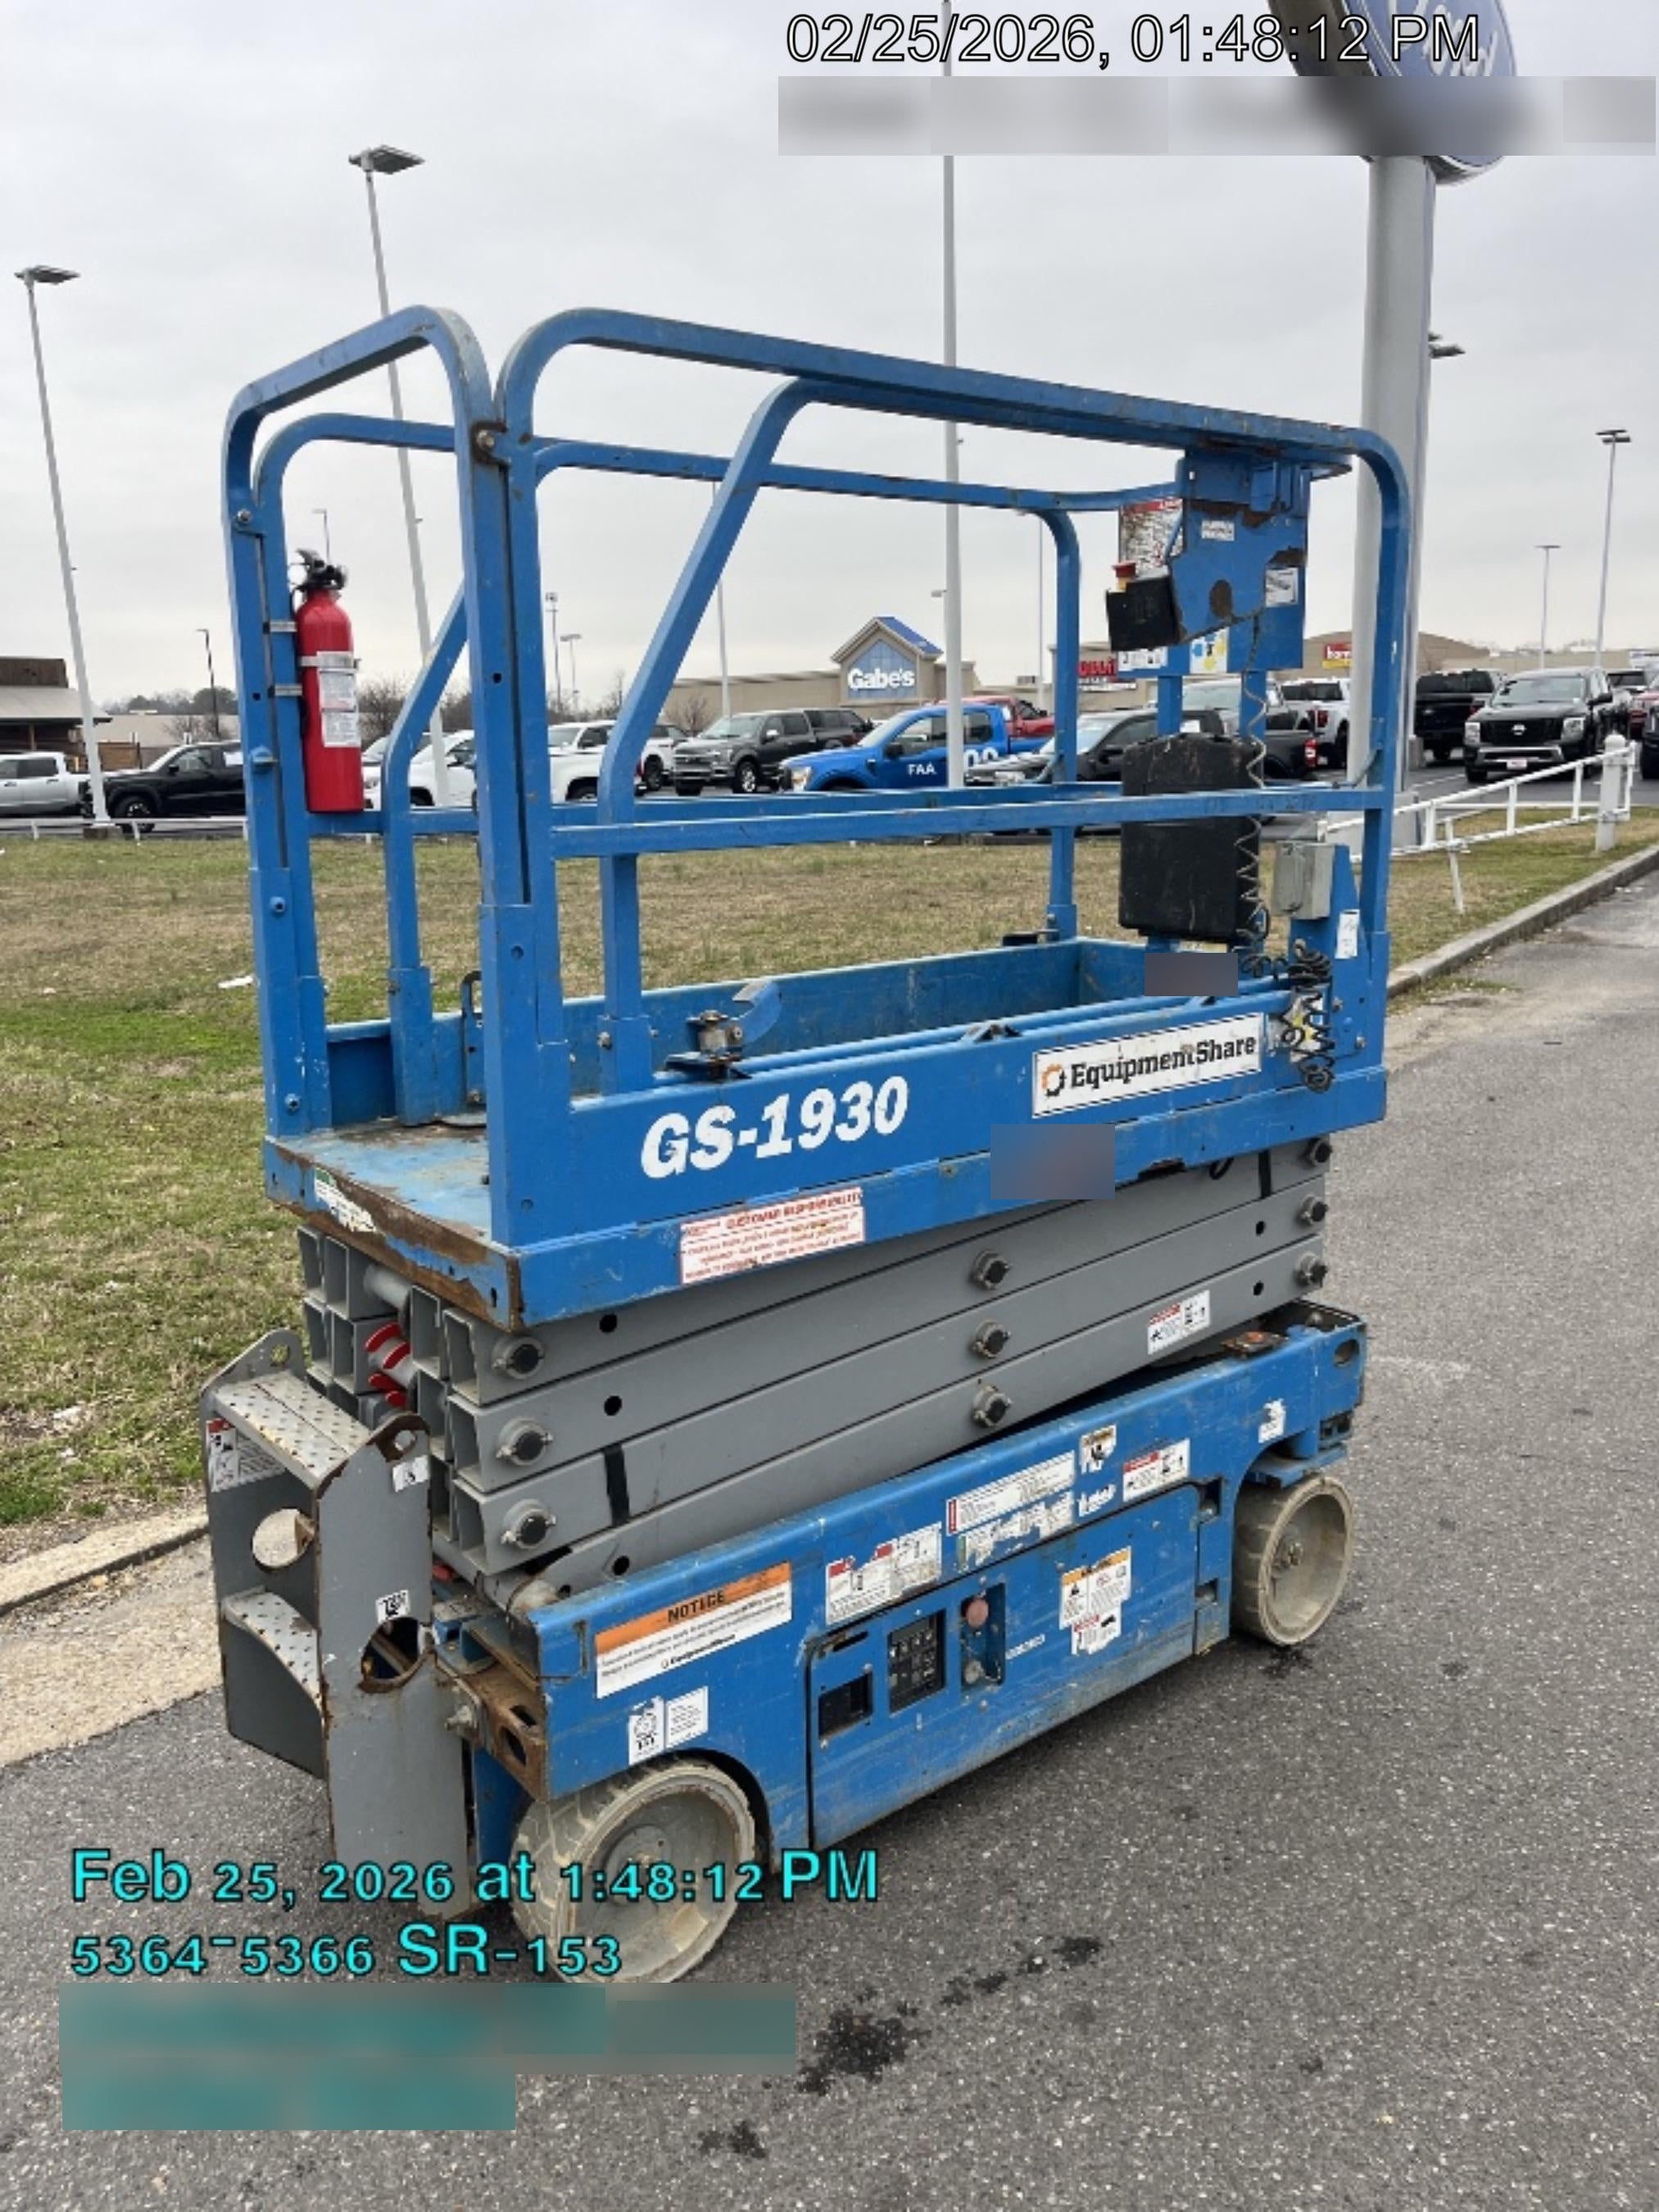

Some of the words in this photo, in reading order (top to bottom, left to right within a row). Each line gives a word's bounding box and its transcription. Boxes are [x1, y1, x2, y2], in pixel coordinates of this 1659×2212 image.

[847, 668, 915, 689] Gabe's
[908, 762, 937, 776] FAA
[1070, 1036, 1257, 1090] EquipmentShare
[640, 1076, 909, 1179] GS-1930
[667, 1590, 727, 1623] NOTICE
